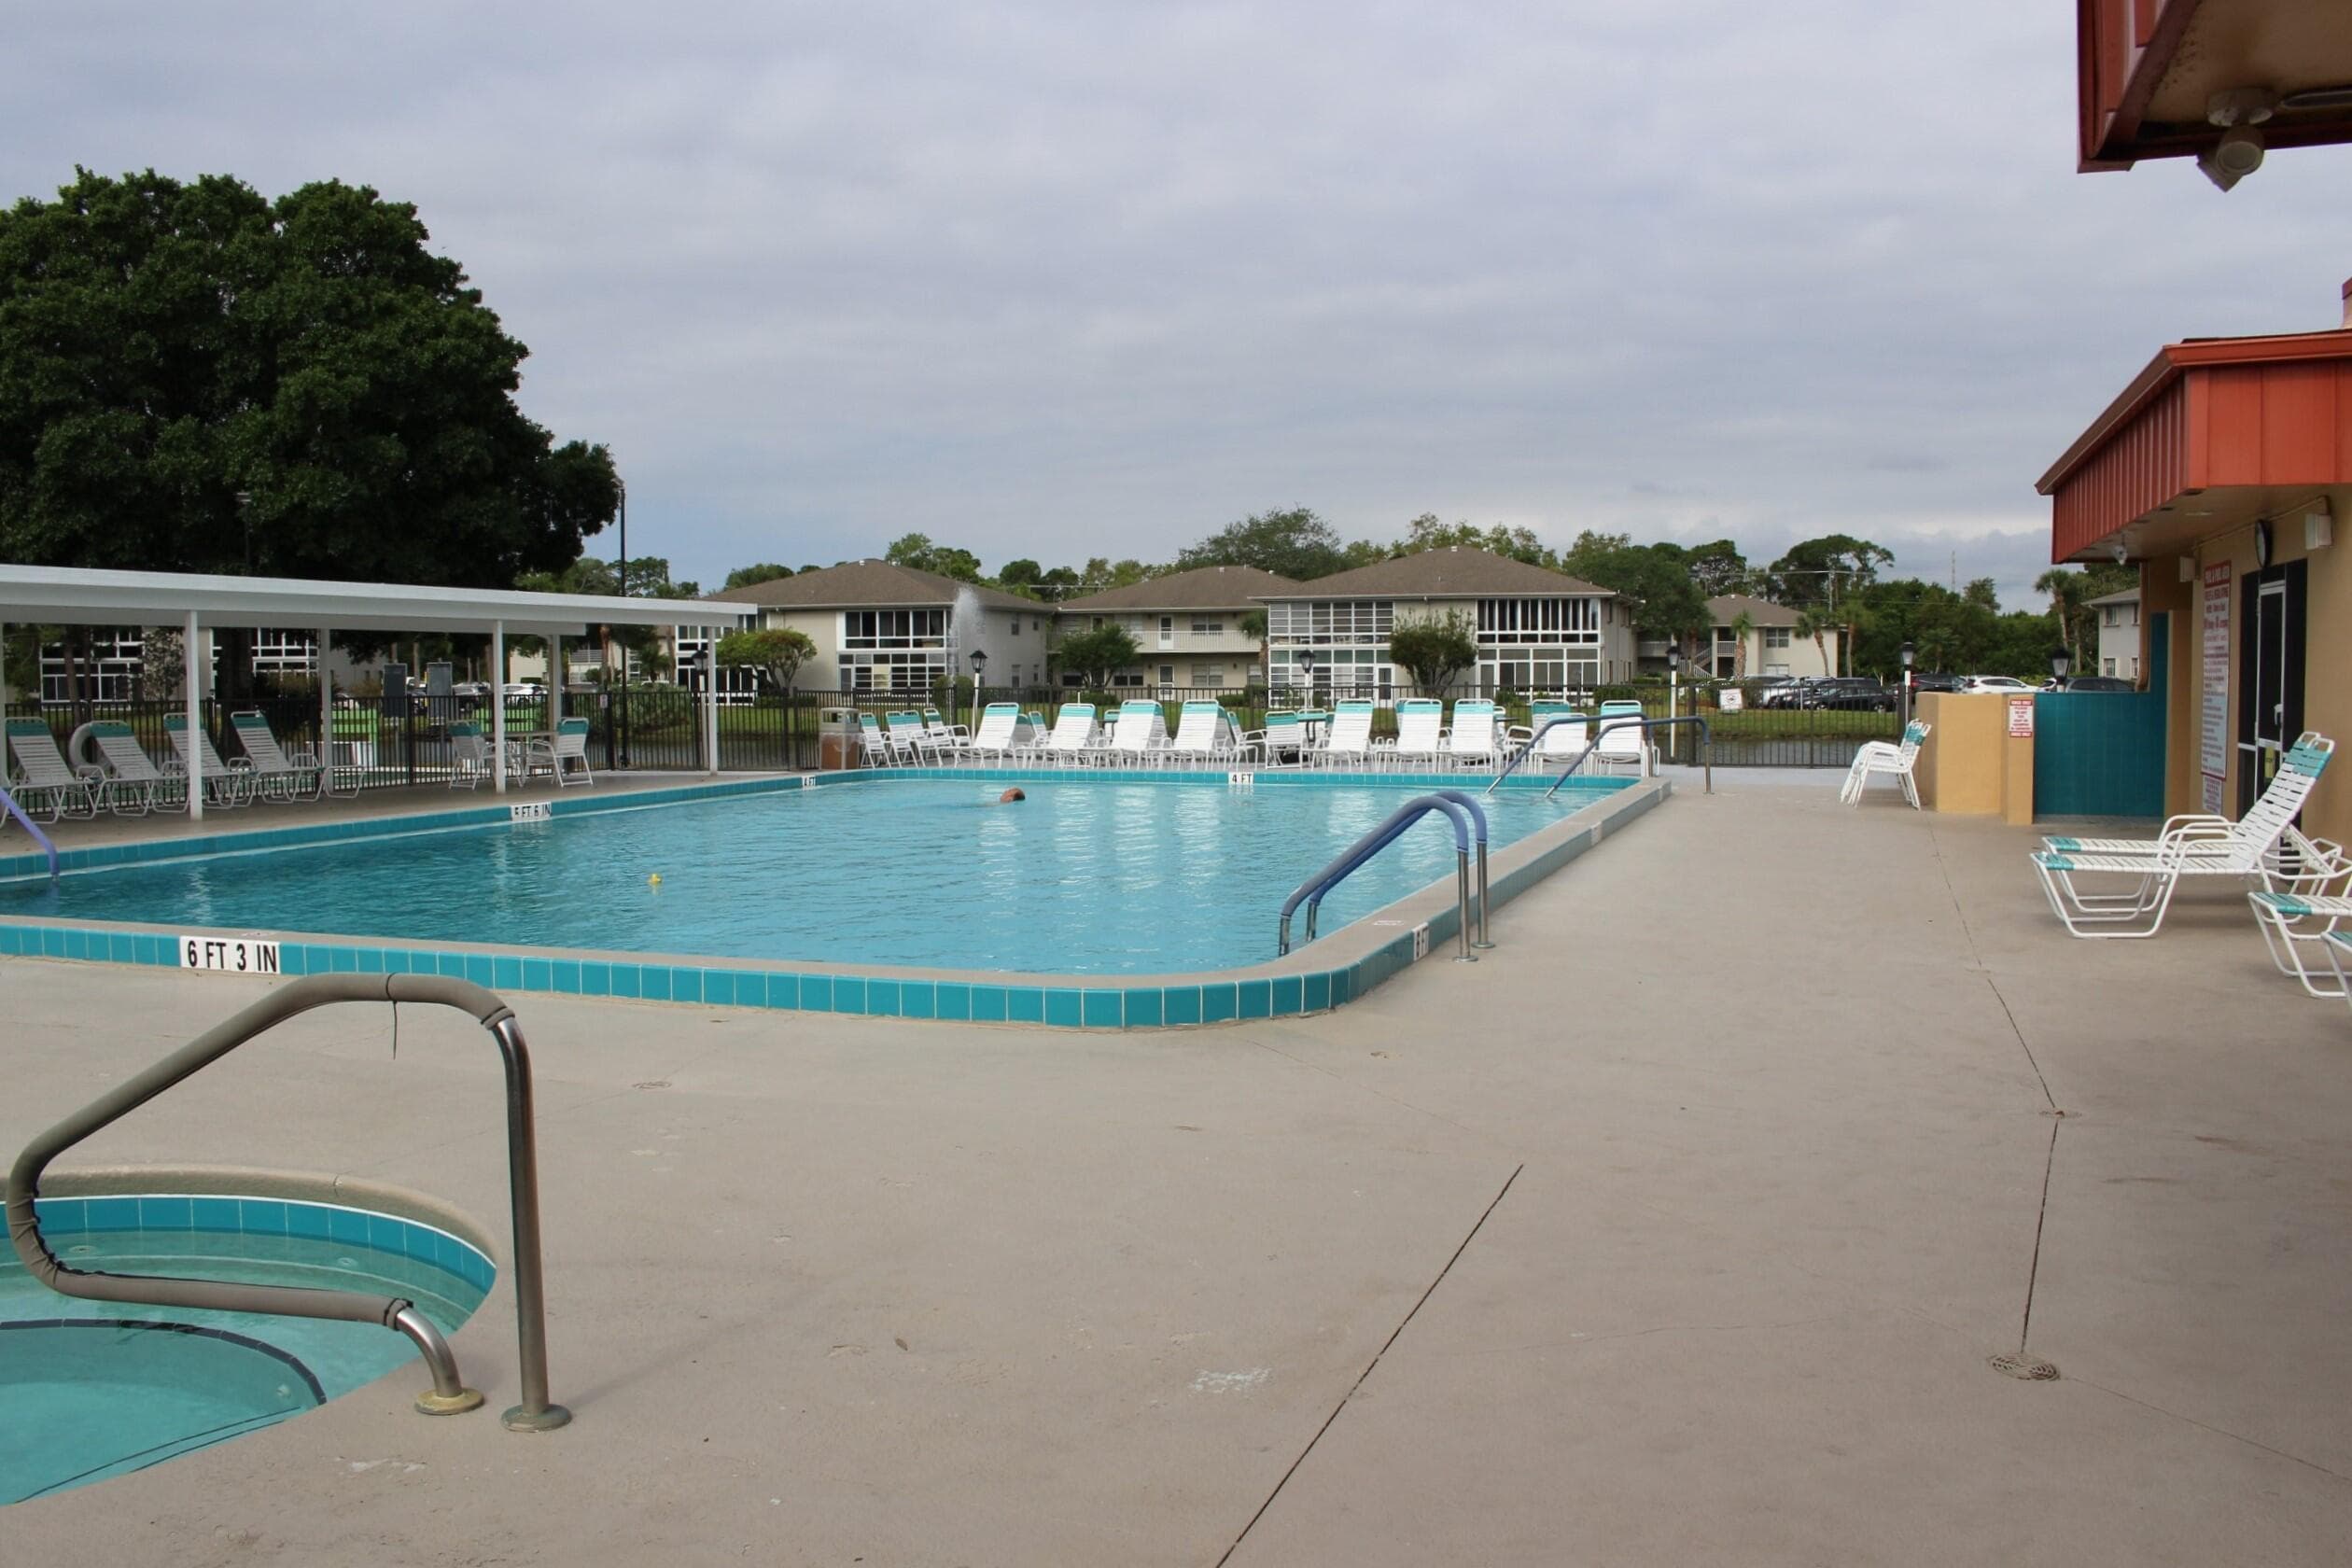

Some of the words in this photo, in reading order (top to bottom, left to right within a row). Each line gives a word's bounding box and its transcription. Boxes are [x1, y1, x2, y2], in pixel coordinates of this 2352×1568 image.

[1232, 774, 1238, 783] 4
[1241, 773, 1252, 784] FT
[522, 805, 531, 818] FT
[542, 803, 551, 815] IN
[188, 940, 198, 968] 6
[205, 942, 227, 969] FT
[236, 943, 246, 972] 3
[257, 944, 277, 973] IN
